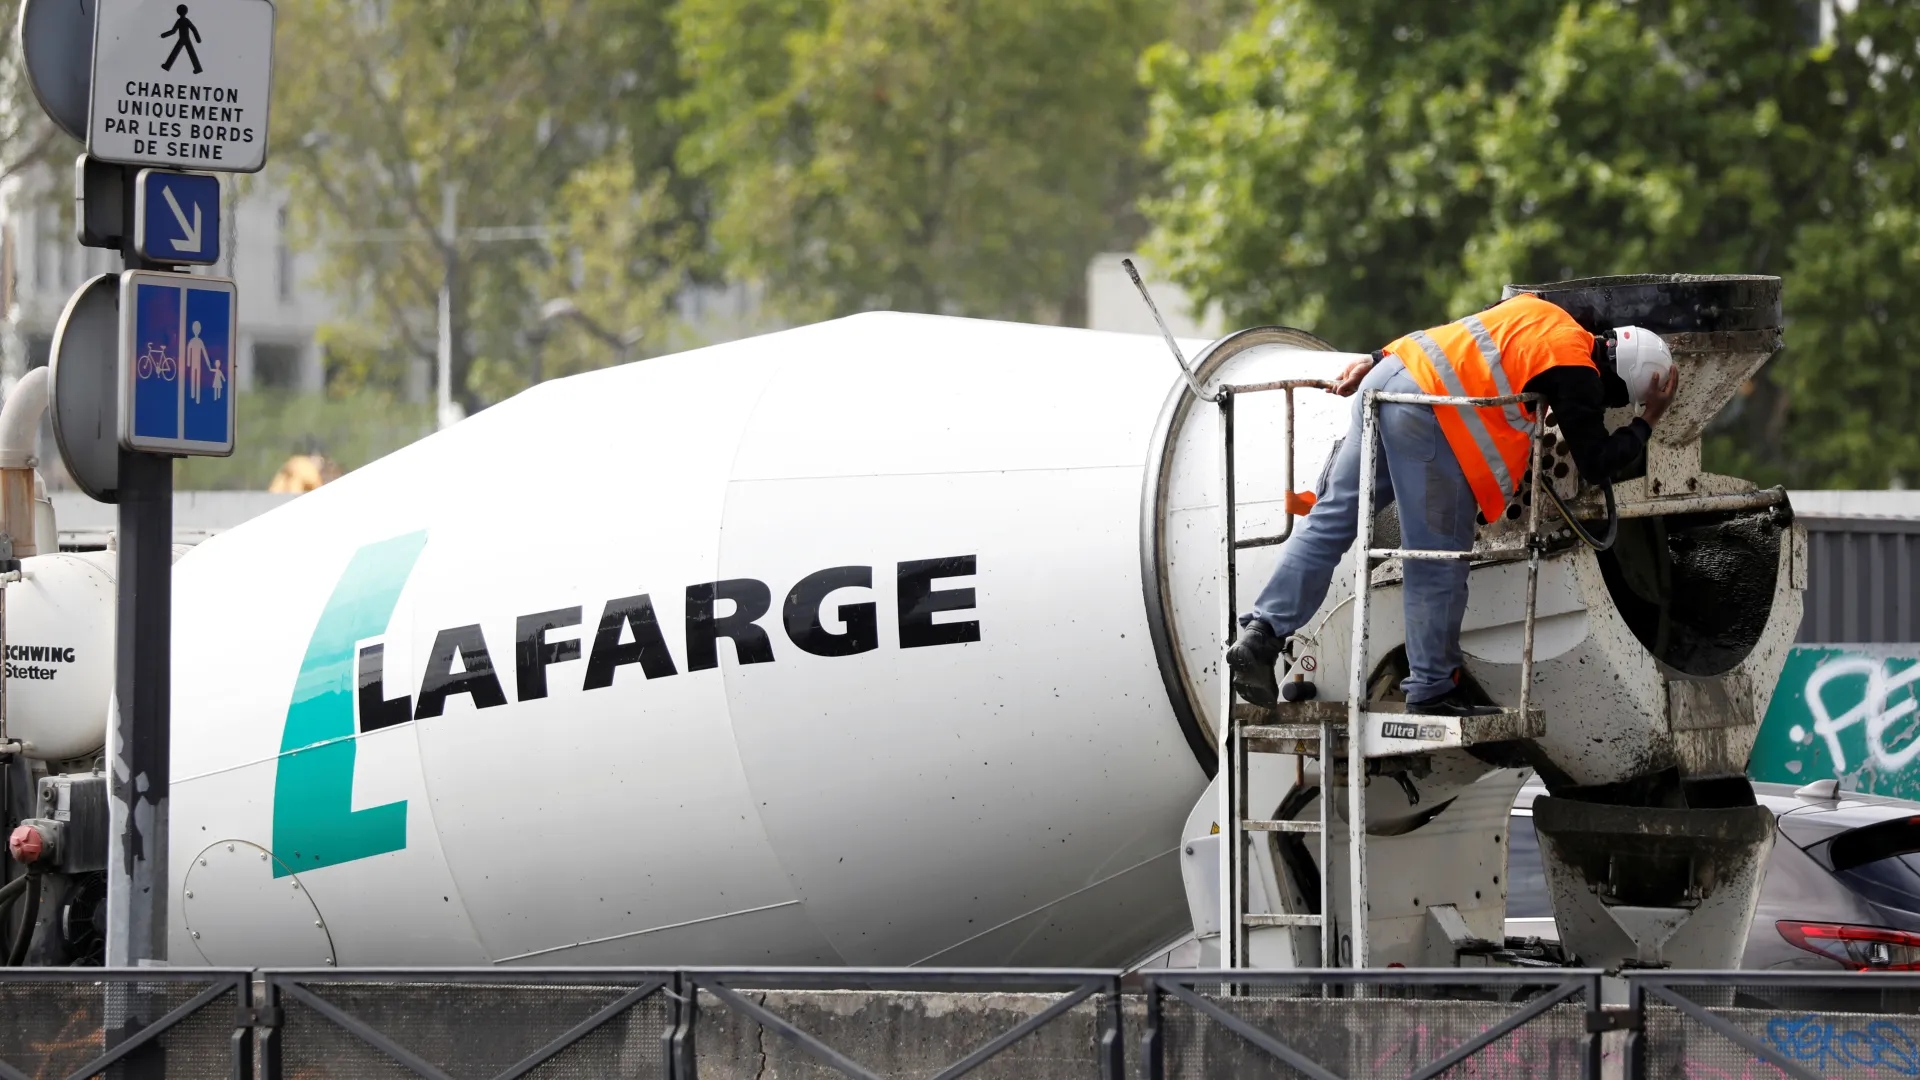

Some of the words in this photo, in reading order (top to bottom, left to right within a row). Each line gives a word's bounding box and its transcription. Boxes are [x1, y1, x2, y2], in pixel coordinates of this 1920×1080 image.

[126, 81, 238, 103] CHARENTON
[118, 100, 243, 122] UNIQUEMENT
[105, 118, 139, 134] PAR
[148, 121, 181, 137] LES
[190, 124, 253, 142] BORDS
[134, 139, 157, 155] DE
[167, 142, 222, 159] SEINE
[359, 554, 981, 734] LAFARGE
[1384, 723, 1415, 738] Ultra
[1420, 726, 1442, 739] Eco
